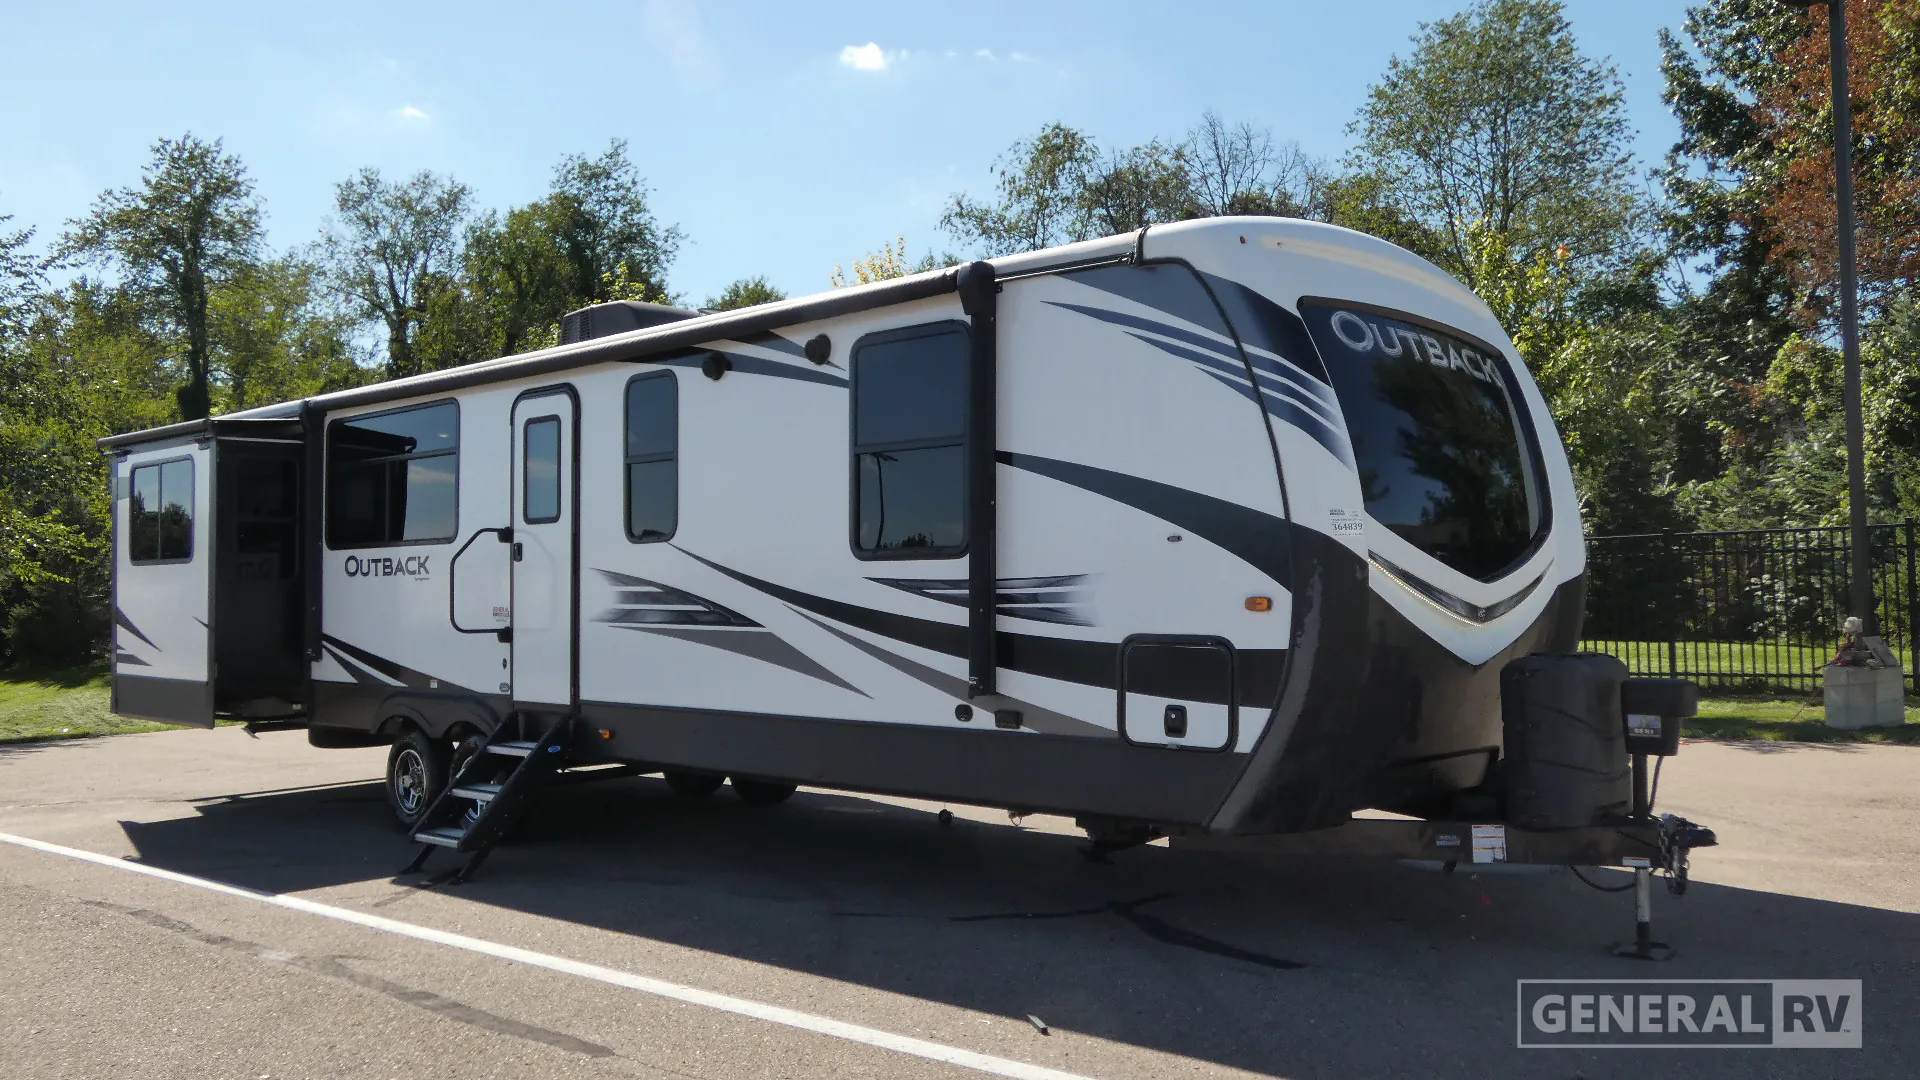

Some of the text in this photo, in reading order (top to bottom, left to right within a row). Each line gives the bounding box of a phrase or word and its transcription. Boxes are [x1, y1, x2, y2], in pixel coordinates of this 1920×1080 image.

[1330, 310, 1502, 388] OUTBACK
[1332, 522, 1363, 531] 364839
[344, 555, 430, 577] OUTBACK
